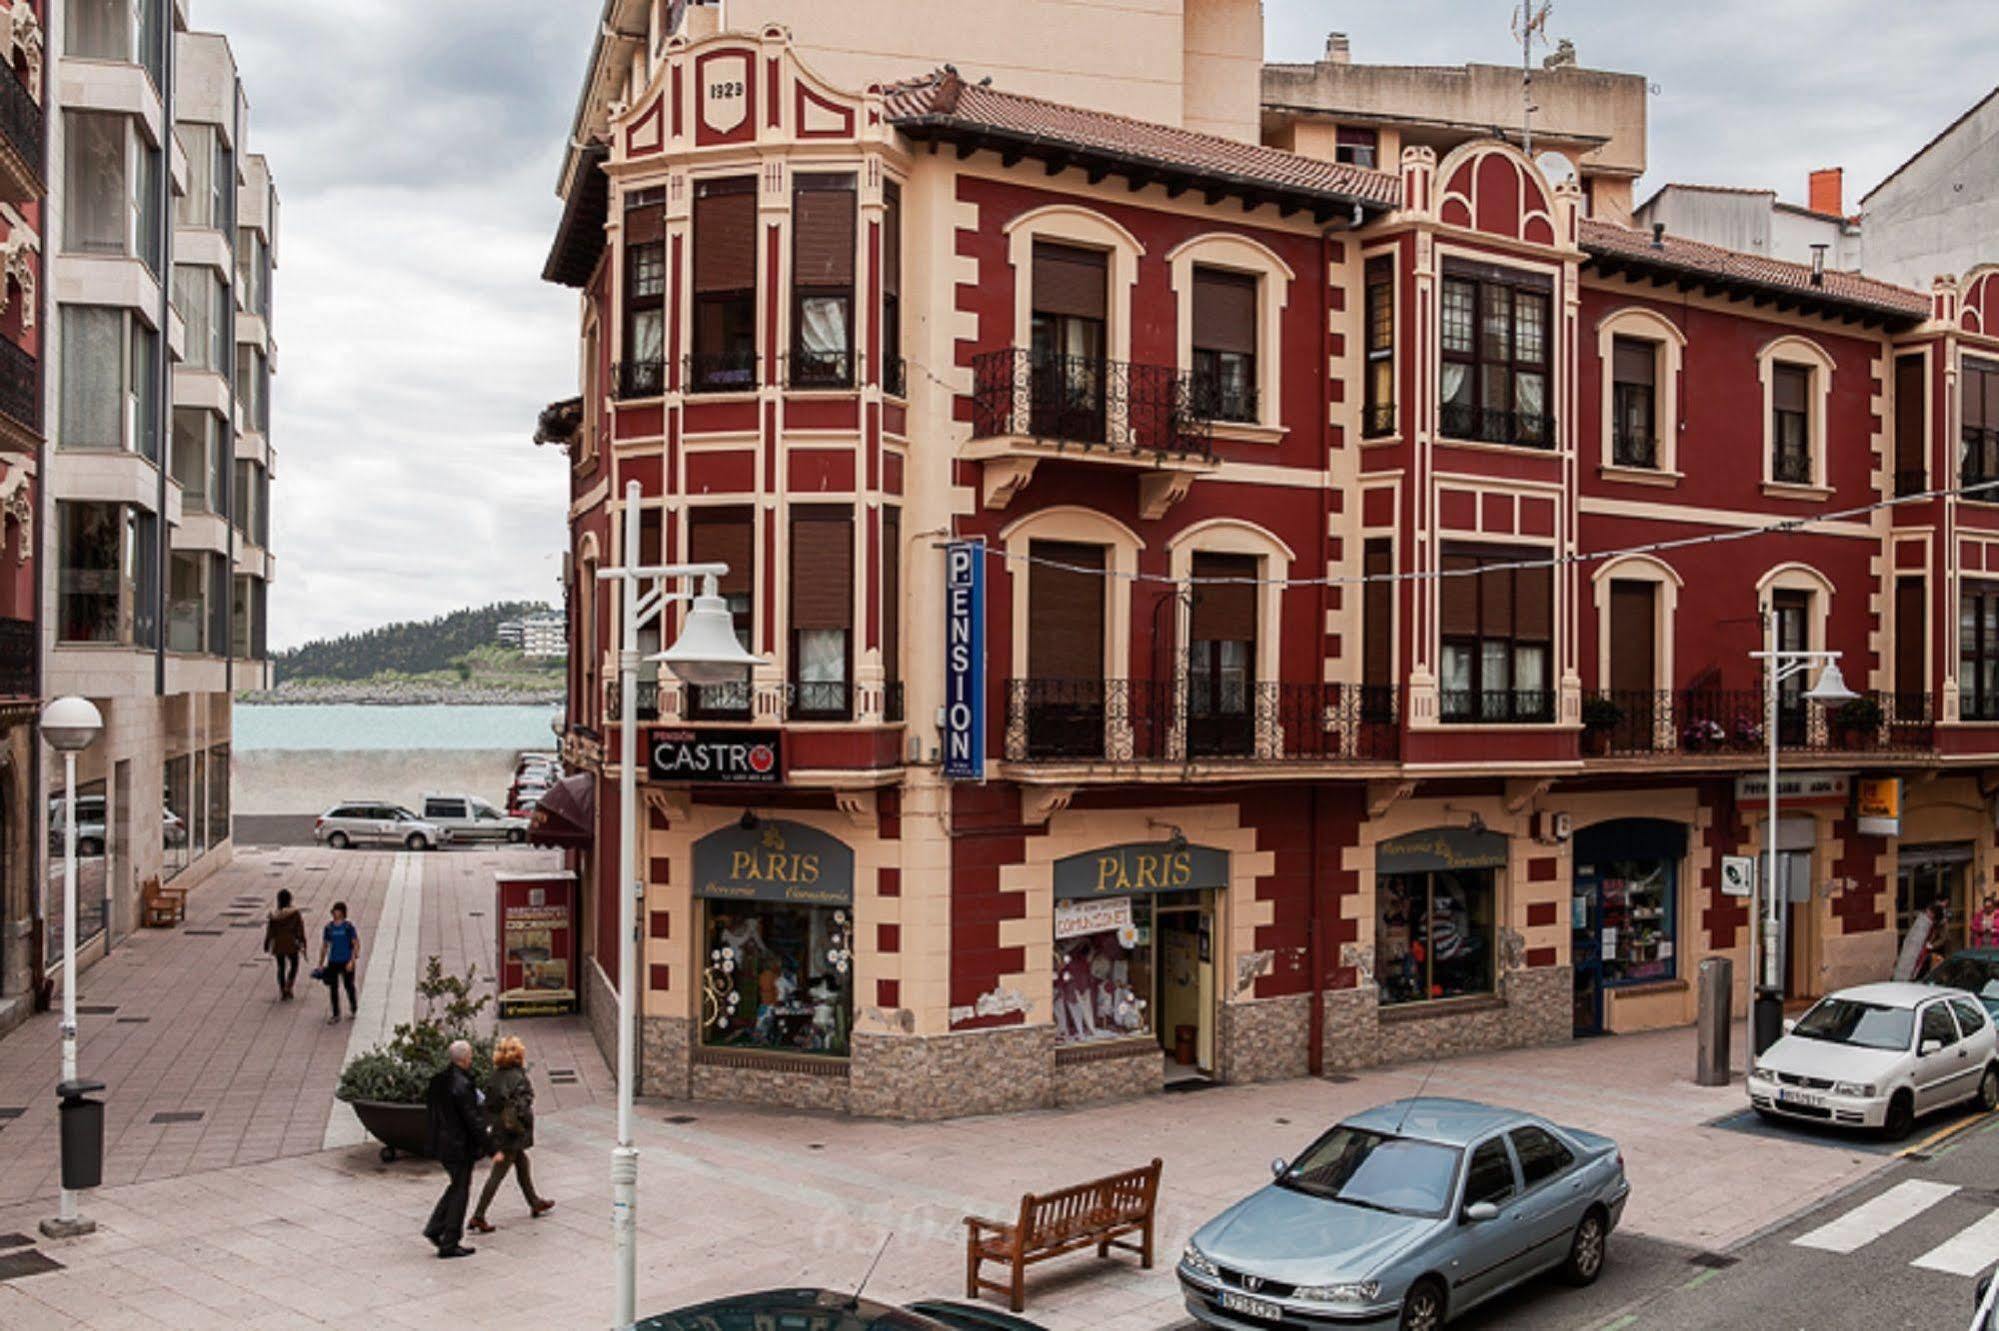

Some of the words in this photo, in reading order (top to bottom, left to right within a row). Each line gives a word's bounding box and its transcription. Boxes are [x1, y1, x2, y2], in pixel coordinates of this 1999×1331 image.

[950, 552, 971, 760] PENSION
[654, 743, 774, 773] CASTRO
[730, 847, 820, 885] PARIS
[1095, 849, 1192, 892] PARIS
